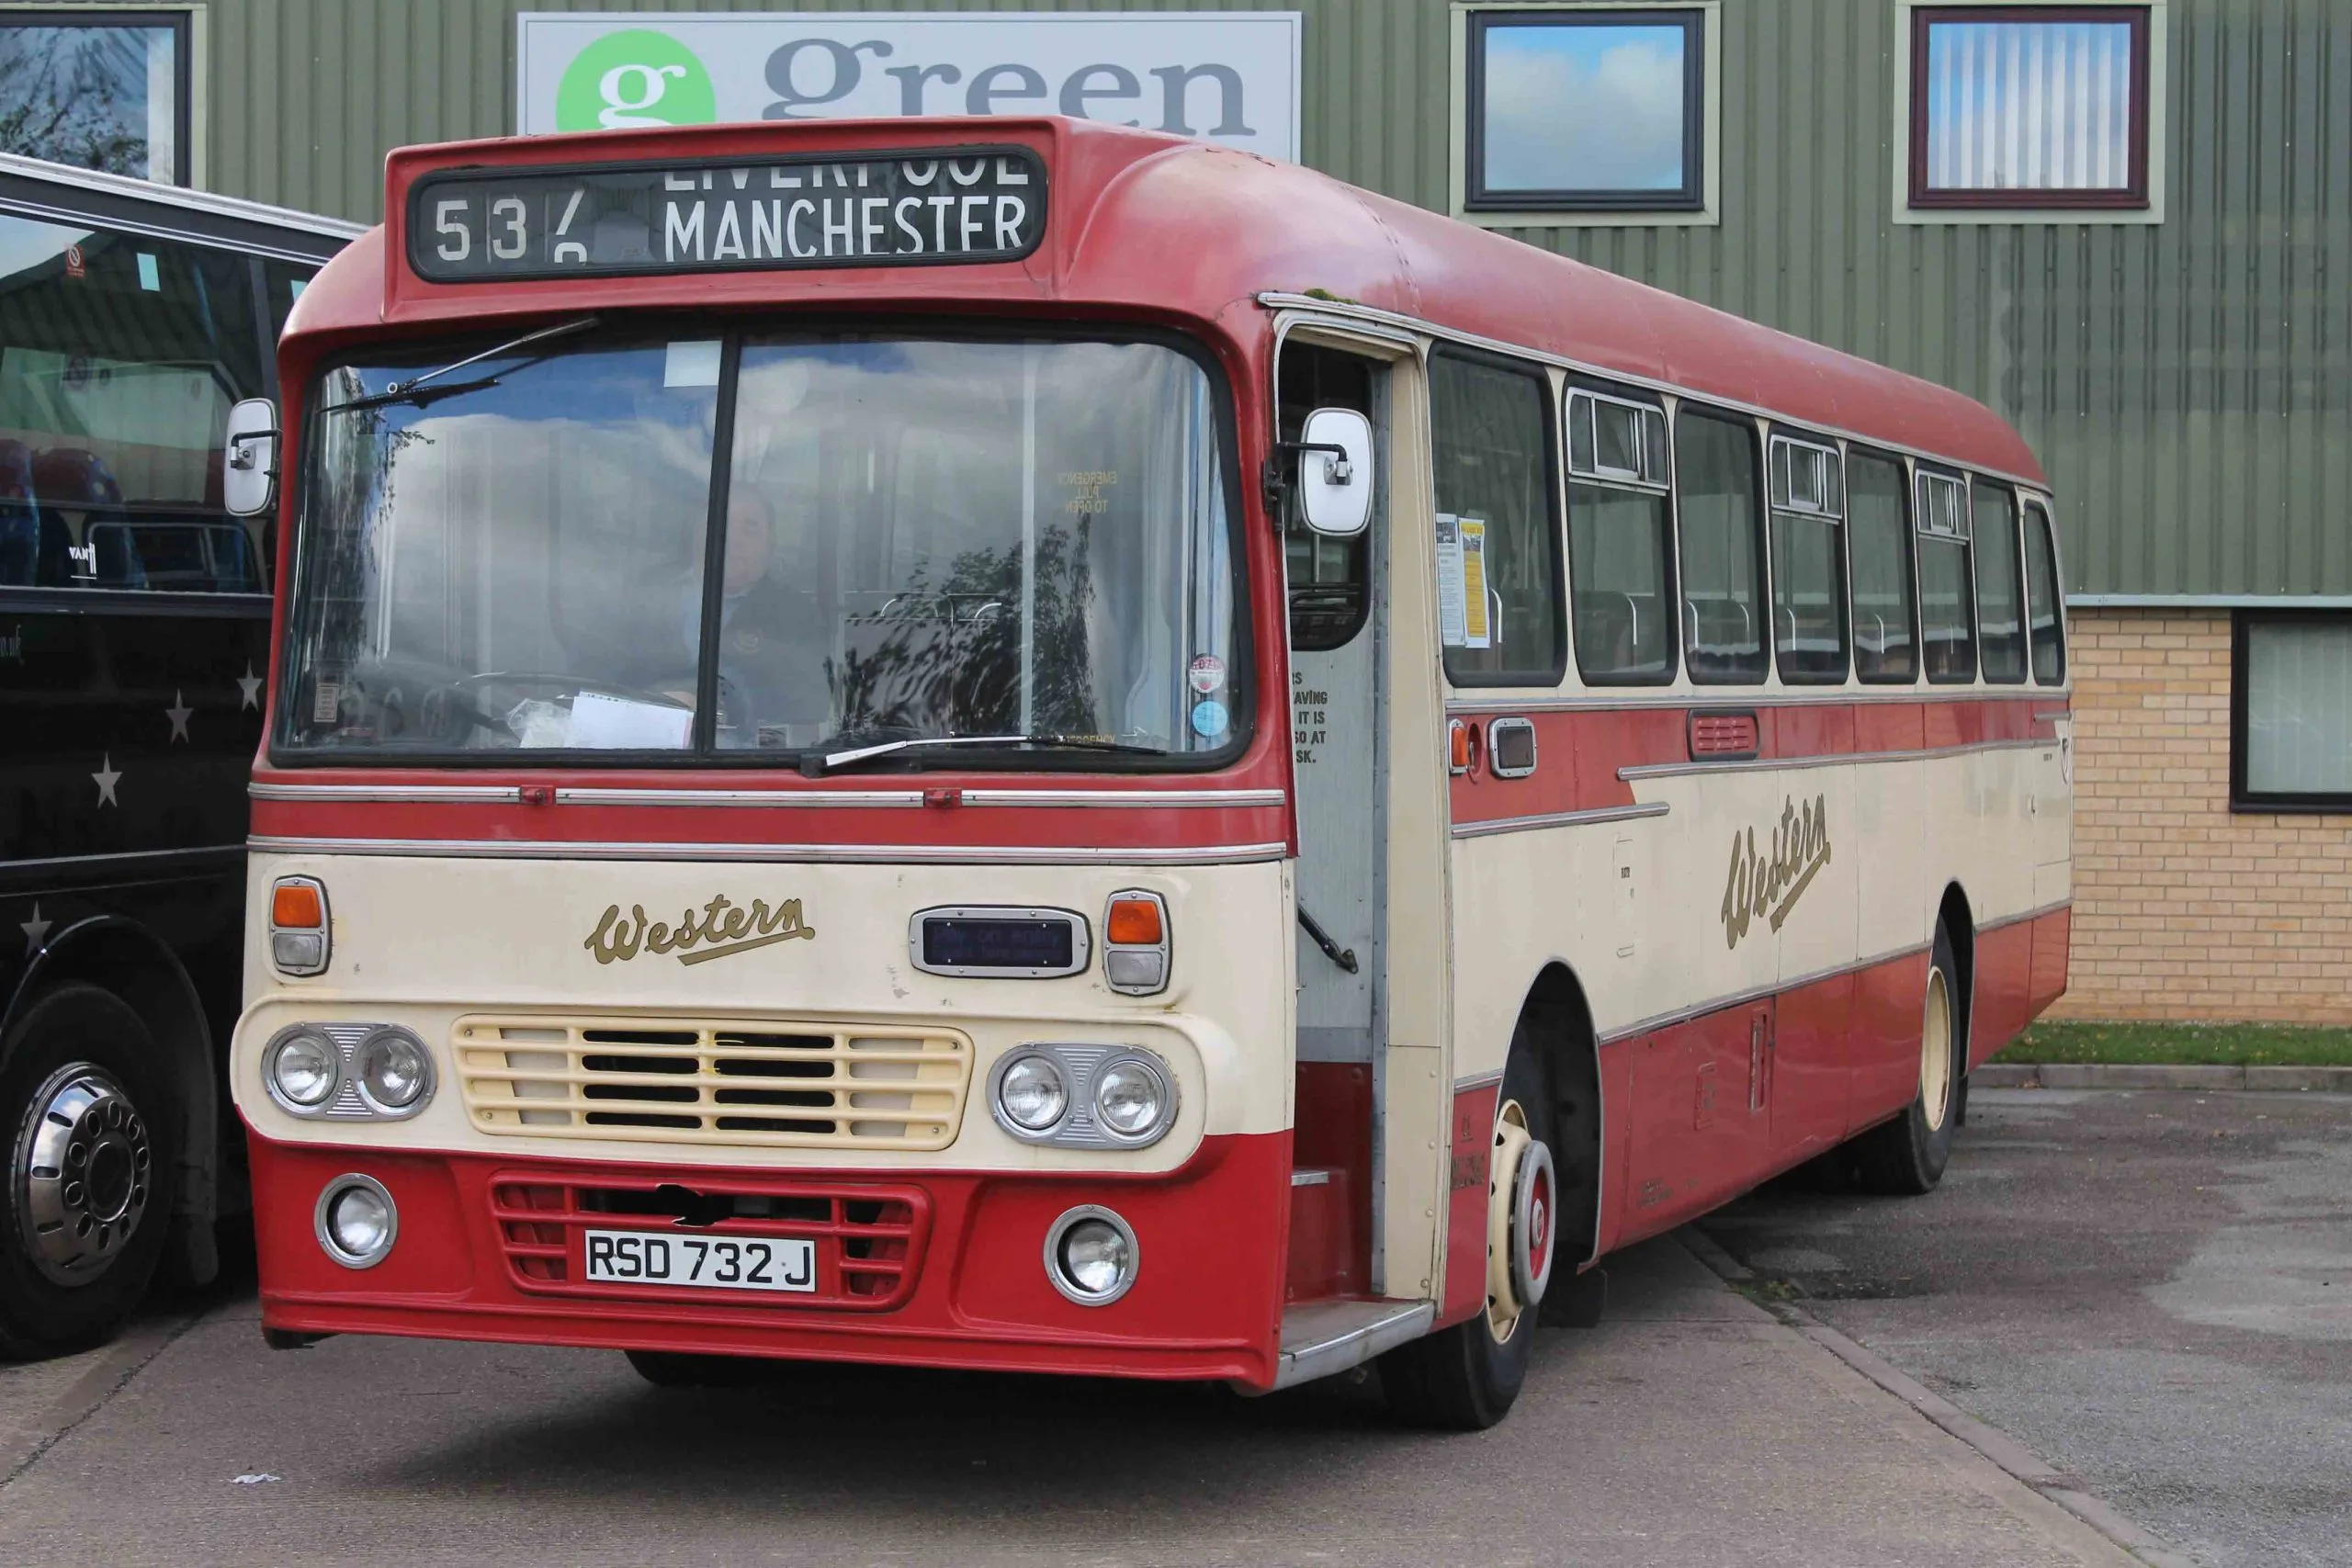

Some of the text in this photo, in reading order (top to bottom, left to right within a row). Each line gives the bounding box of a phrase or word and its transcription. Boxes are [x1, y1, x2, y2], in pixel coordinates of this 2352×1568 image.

[599, 64, 686, 130] g
[763, 38, 1257, 137] green
[665, 196, 1026, 263] MANCHESTER
[1294, 690, 1328, 705] AVING
[1298, 711, 1325, 724] IT IS
[1296, 750, 1317, 763] SK.
[1311, 730, 1326, 745] AT
[1722, 793, 1831, 950] Western
[584, 894, 816, 966] Western
[589, 1235, 670, 1279] RSD
